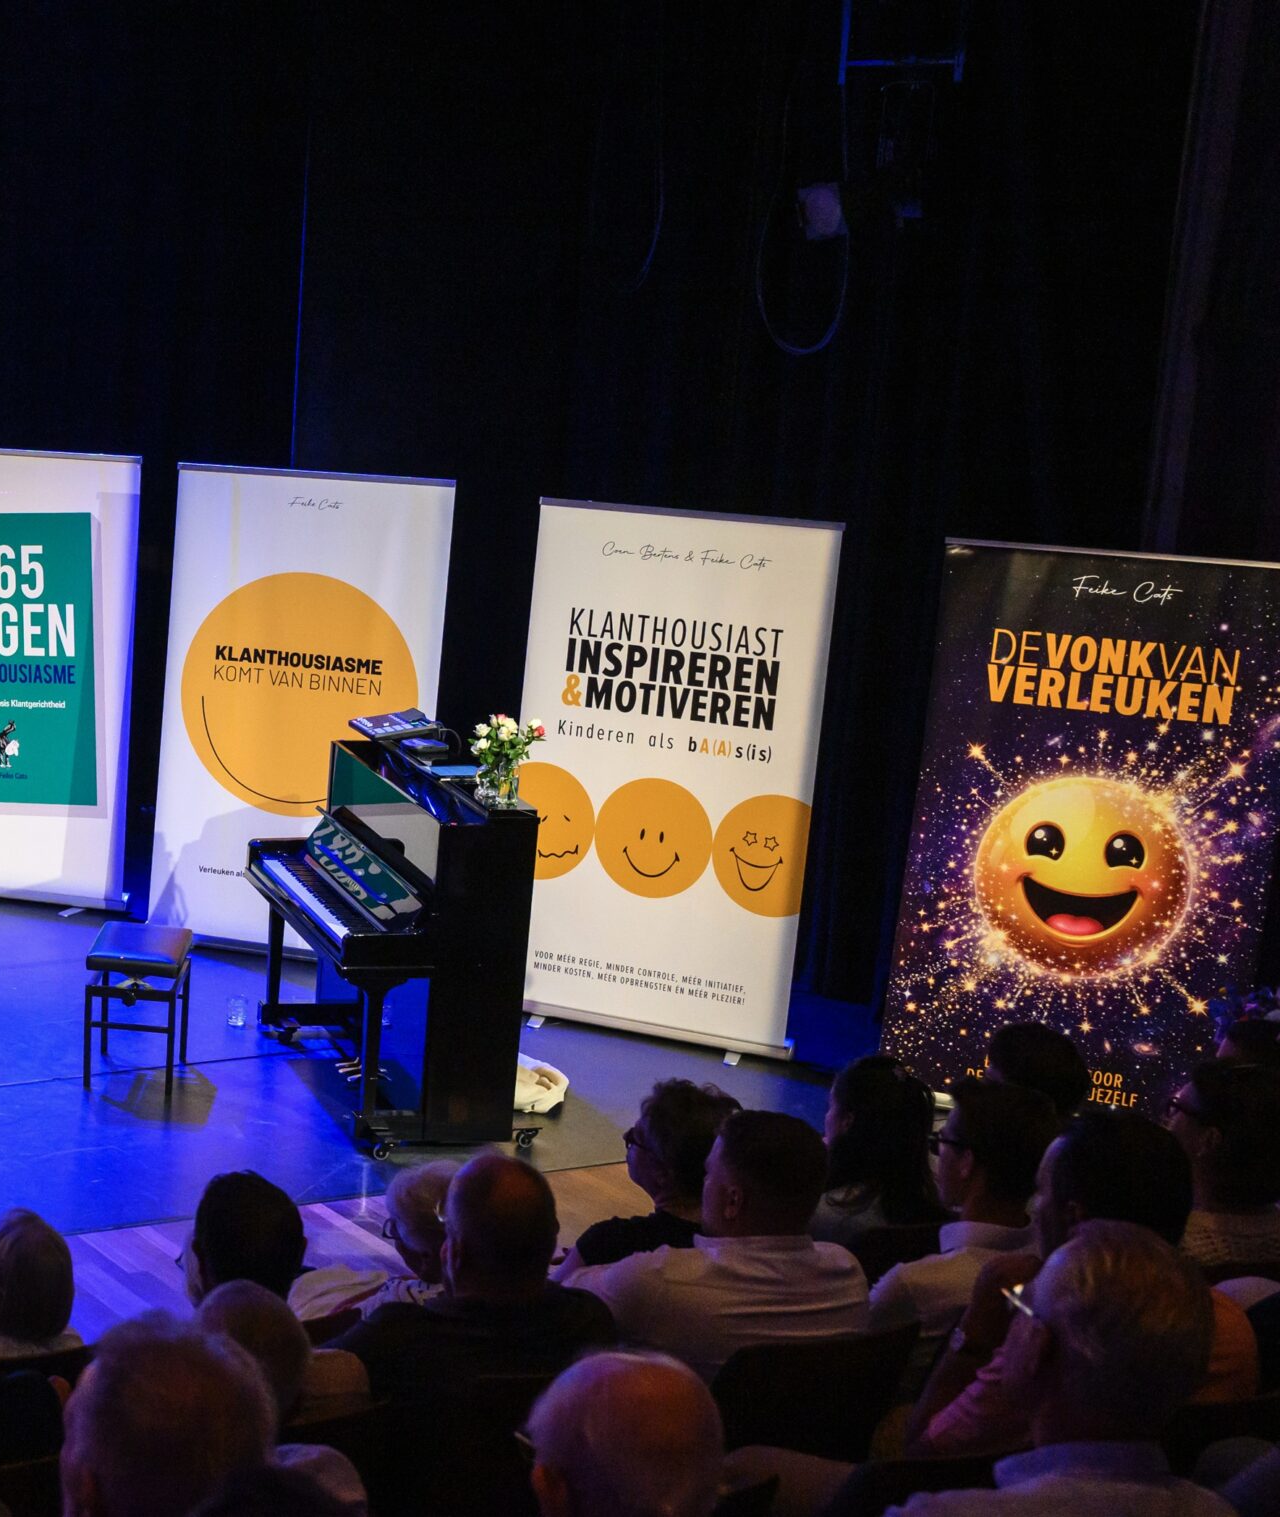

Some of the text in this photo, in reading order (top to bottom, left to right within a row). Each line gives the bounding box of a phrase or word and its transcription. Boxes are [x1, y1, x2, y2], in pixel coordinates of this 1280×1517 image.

[684, 550, 694, 562] &
[700, 549, 736, 566] Feike
[740, 554, 773, 572] Cats
[1072, 575, 1184, 606] Feike Cats
[569, 607, 784, 658] KLANTHOUSIAST
[215, 645, 383, 676] KLANTHOUSIASME
[565, 637, 781, 696] INSPIREREN
[213, 664, 382, 697] KOMT VAN BINNEN
[987, 663, 1236, 726] VERLEUKEN
[11, 699, 66, 709] Klantgerichtheid
[561, 674, 777, 731] &MOTIVEREN
[558, 719, 635, 745] Kinderen
[648, 733, 675, 750] als
[199, 865, 234, 877] Verleuken
[533, 961, 562, 974] MINDER
[564, 967, 595, 980] KOSTEN,
[619, 976, 672, 993] OPBRENGSTEN
[711, 991, 746, 1006] PLEZIER!
[535, 950, 554, 960] VOOR
[579, 957, 602, 969] REGIE,
[606, 962, 635, 975] MINDER
[637, 967, 678, 983] CONTROLE,
[705, 979, 746, 995] INITIATIEF,
[1088, 1069, 1123, 1089] OOR
[1087, 1086, 1139, 1108] JEZELF
